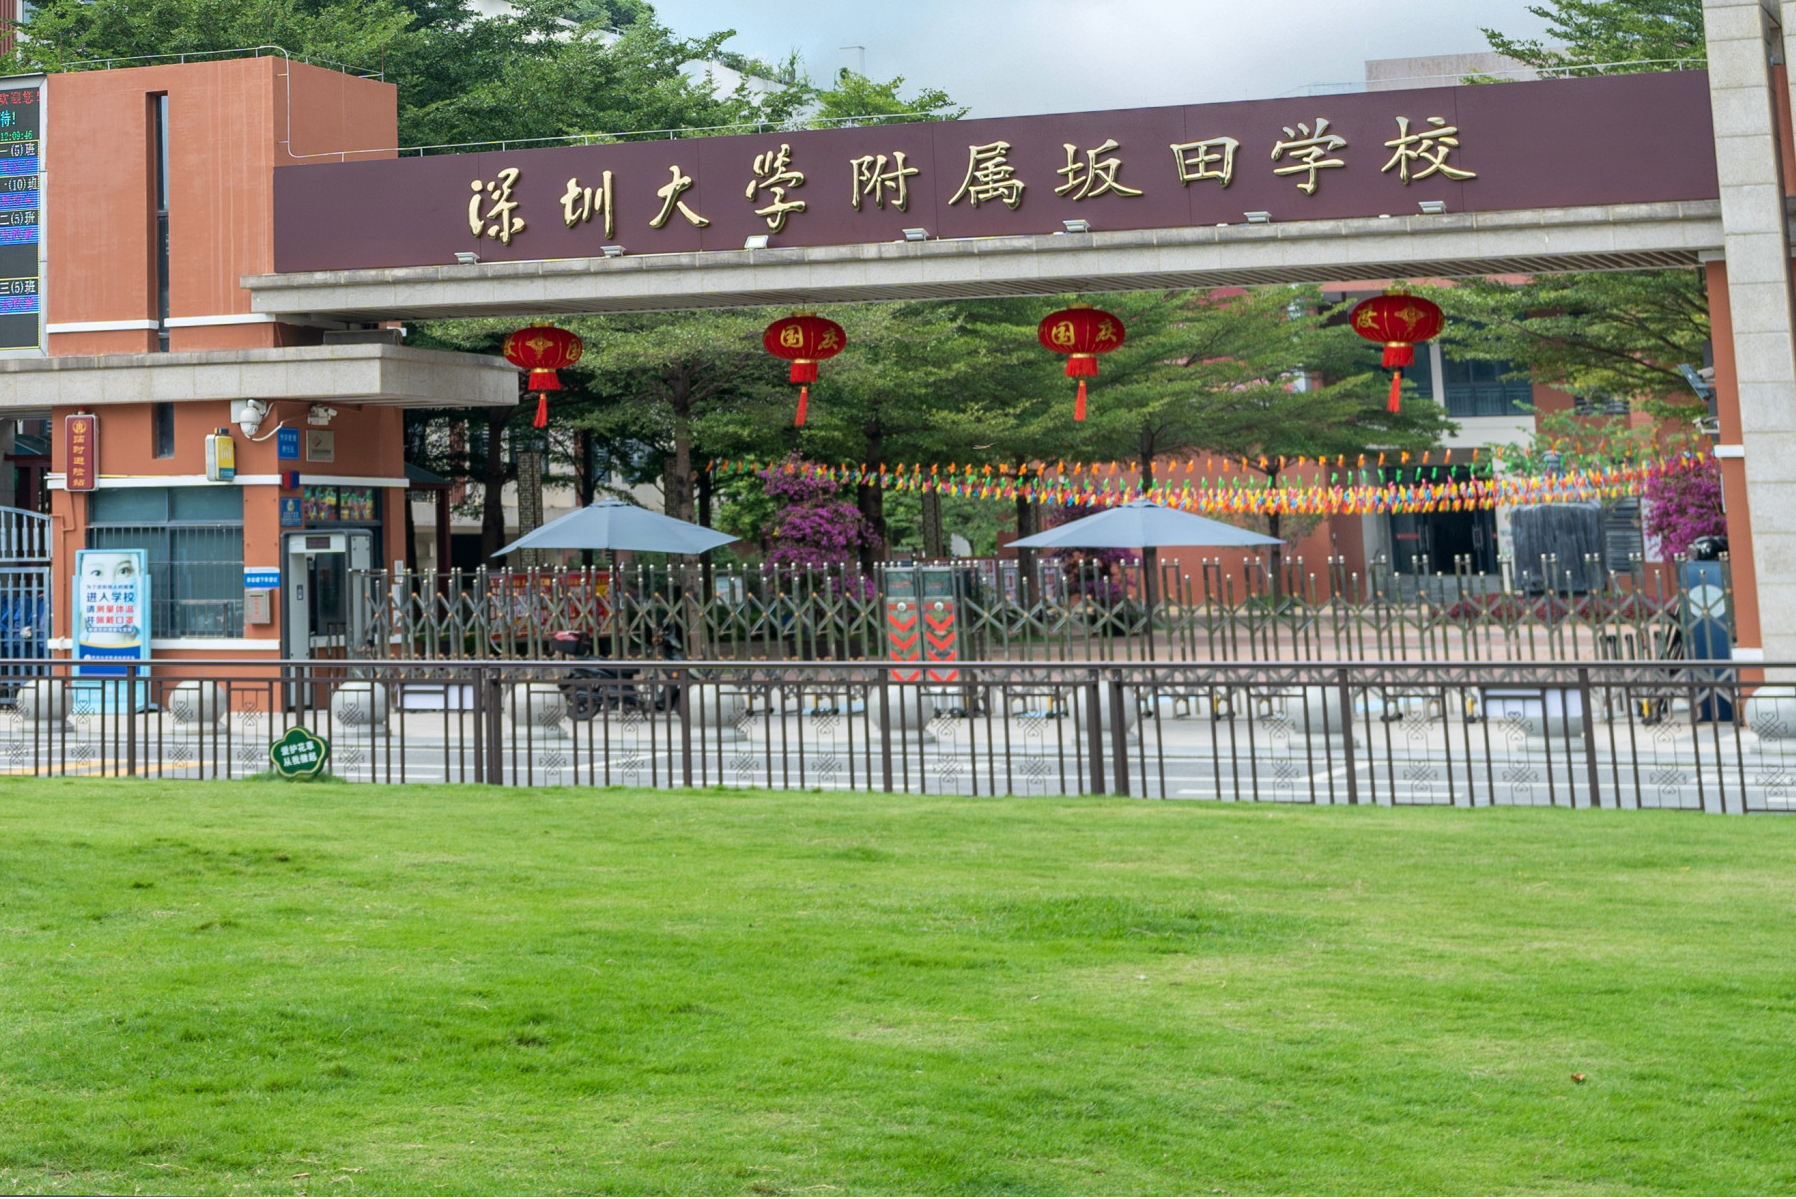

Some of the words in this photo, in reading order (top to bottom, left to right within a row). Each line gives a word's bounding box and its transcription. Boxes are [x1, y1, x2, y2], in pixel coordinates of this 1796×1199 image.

[780, 325, 839, 350] 国庆
[1051, 318, 1117, 345] 国庆
[86, 591, 135, 603] 进入学校
